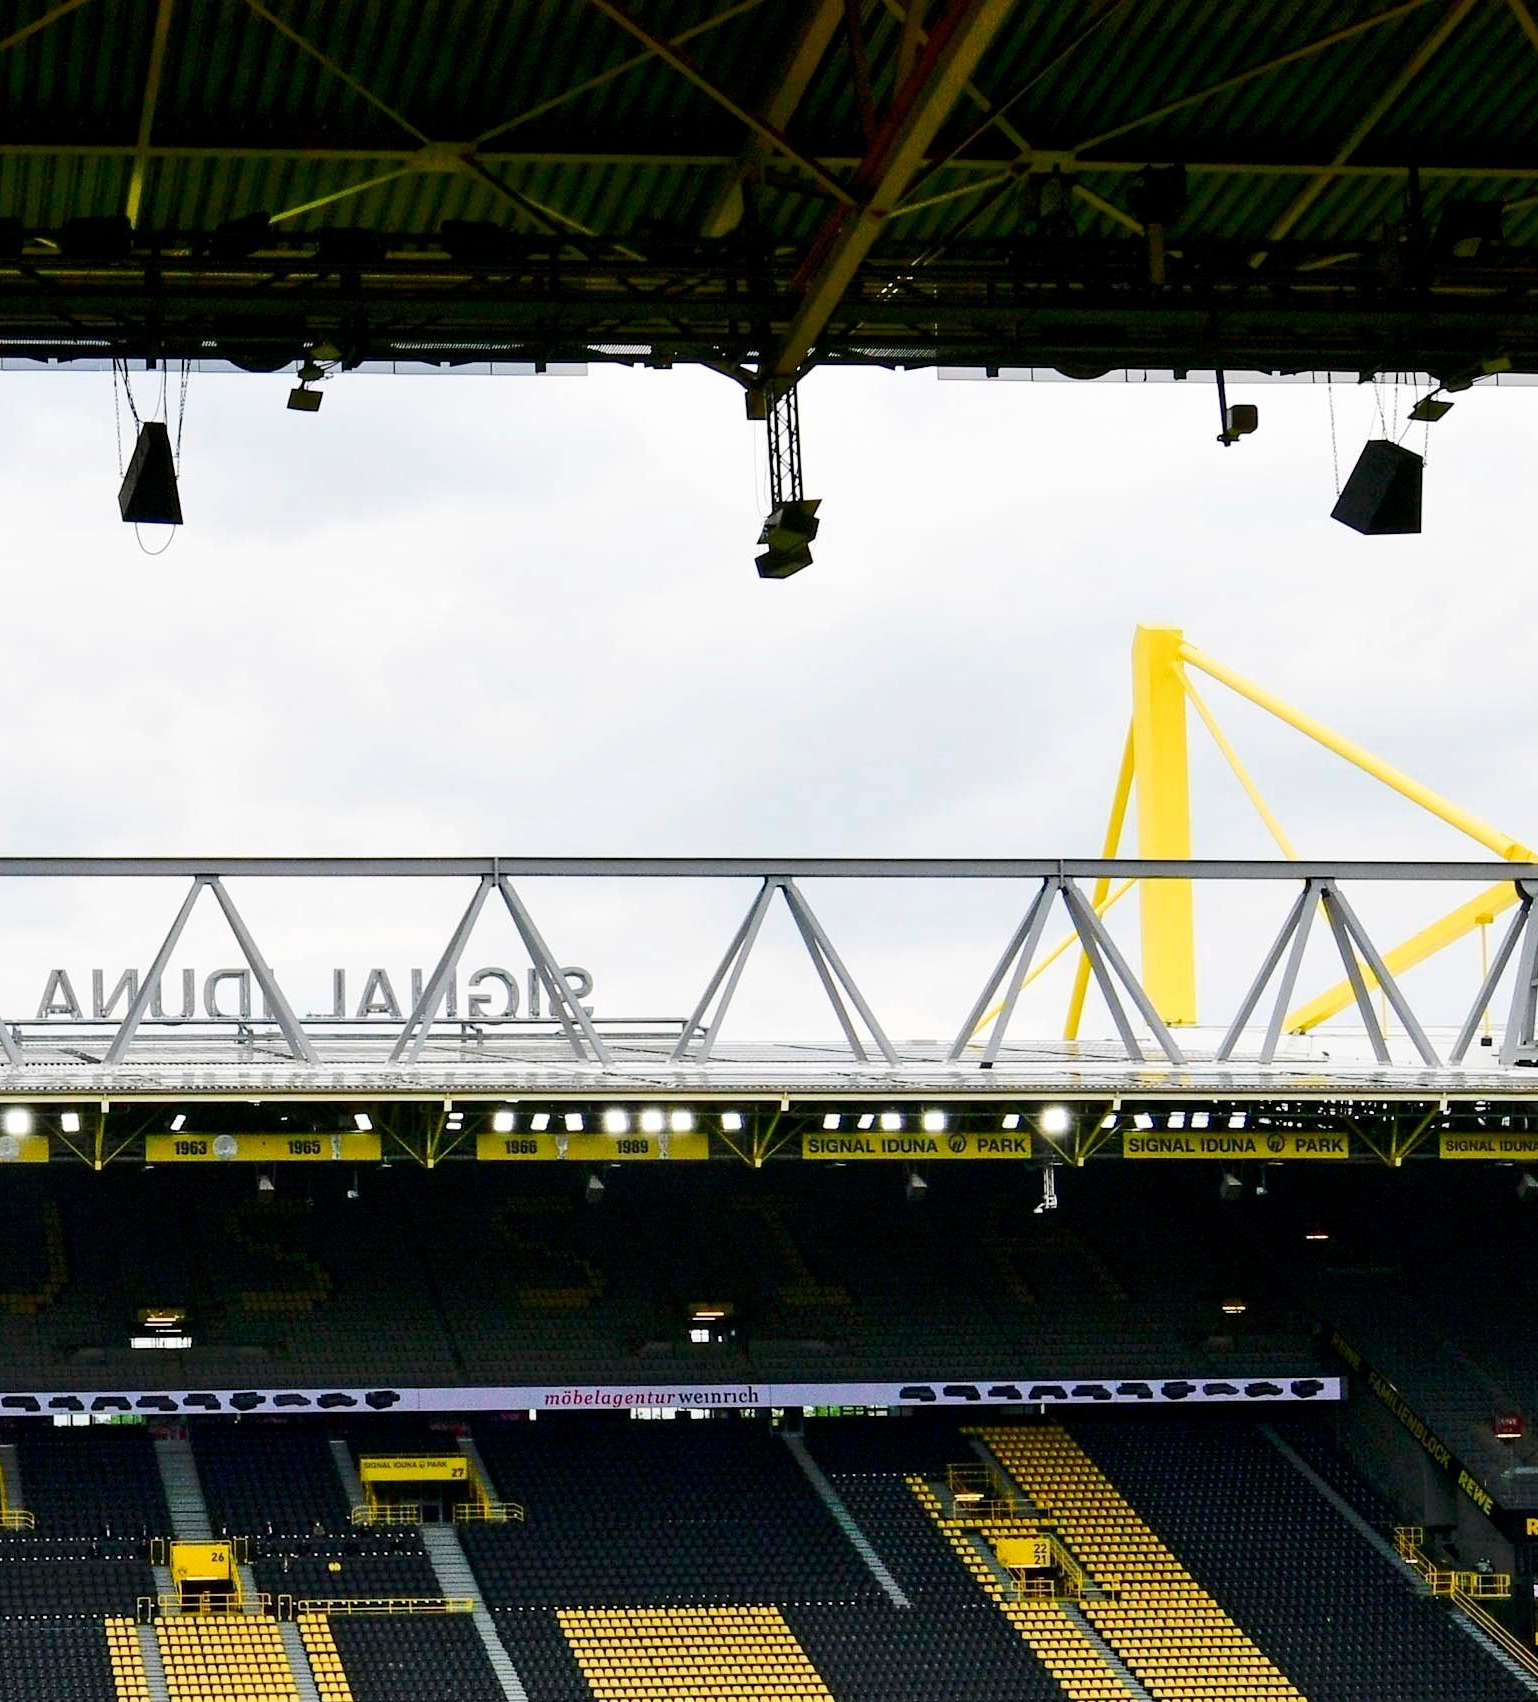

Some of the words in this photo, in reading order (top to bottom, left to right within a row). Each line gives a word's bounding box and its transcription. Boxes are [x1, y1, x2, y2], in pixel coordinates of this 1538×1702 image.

[173, 1140, 207, 1156] 1963
[287, 1140, 322, 1155] 1965
[505, 1139, 538, 1154] 1966
[616, 1139, 649, 1154] 1989
[807, 1139, 876, 1154] SIGNAL
[880, 1139, 938, 1154] IDUNA
[976, 1138, 1027, 1153] PARK
[1128, 1138, 1196, 1153] SIGNAL
[1201, 1138, 1257, 1153] IDUNA
[1294, 1138, 1345, 1153] PARK
[544, 1386, 674, 1409] möbelagentur
[452, 1468, 464, 1477] 27
[1458, 1470, 1493, 1516] REWE
[1034, 1543, 1047, 1553] 22
[211, 1552, 225, 1562] 26
[1034, 1555, 1046, 1565] 21
